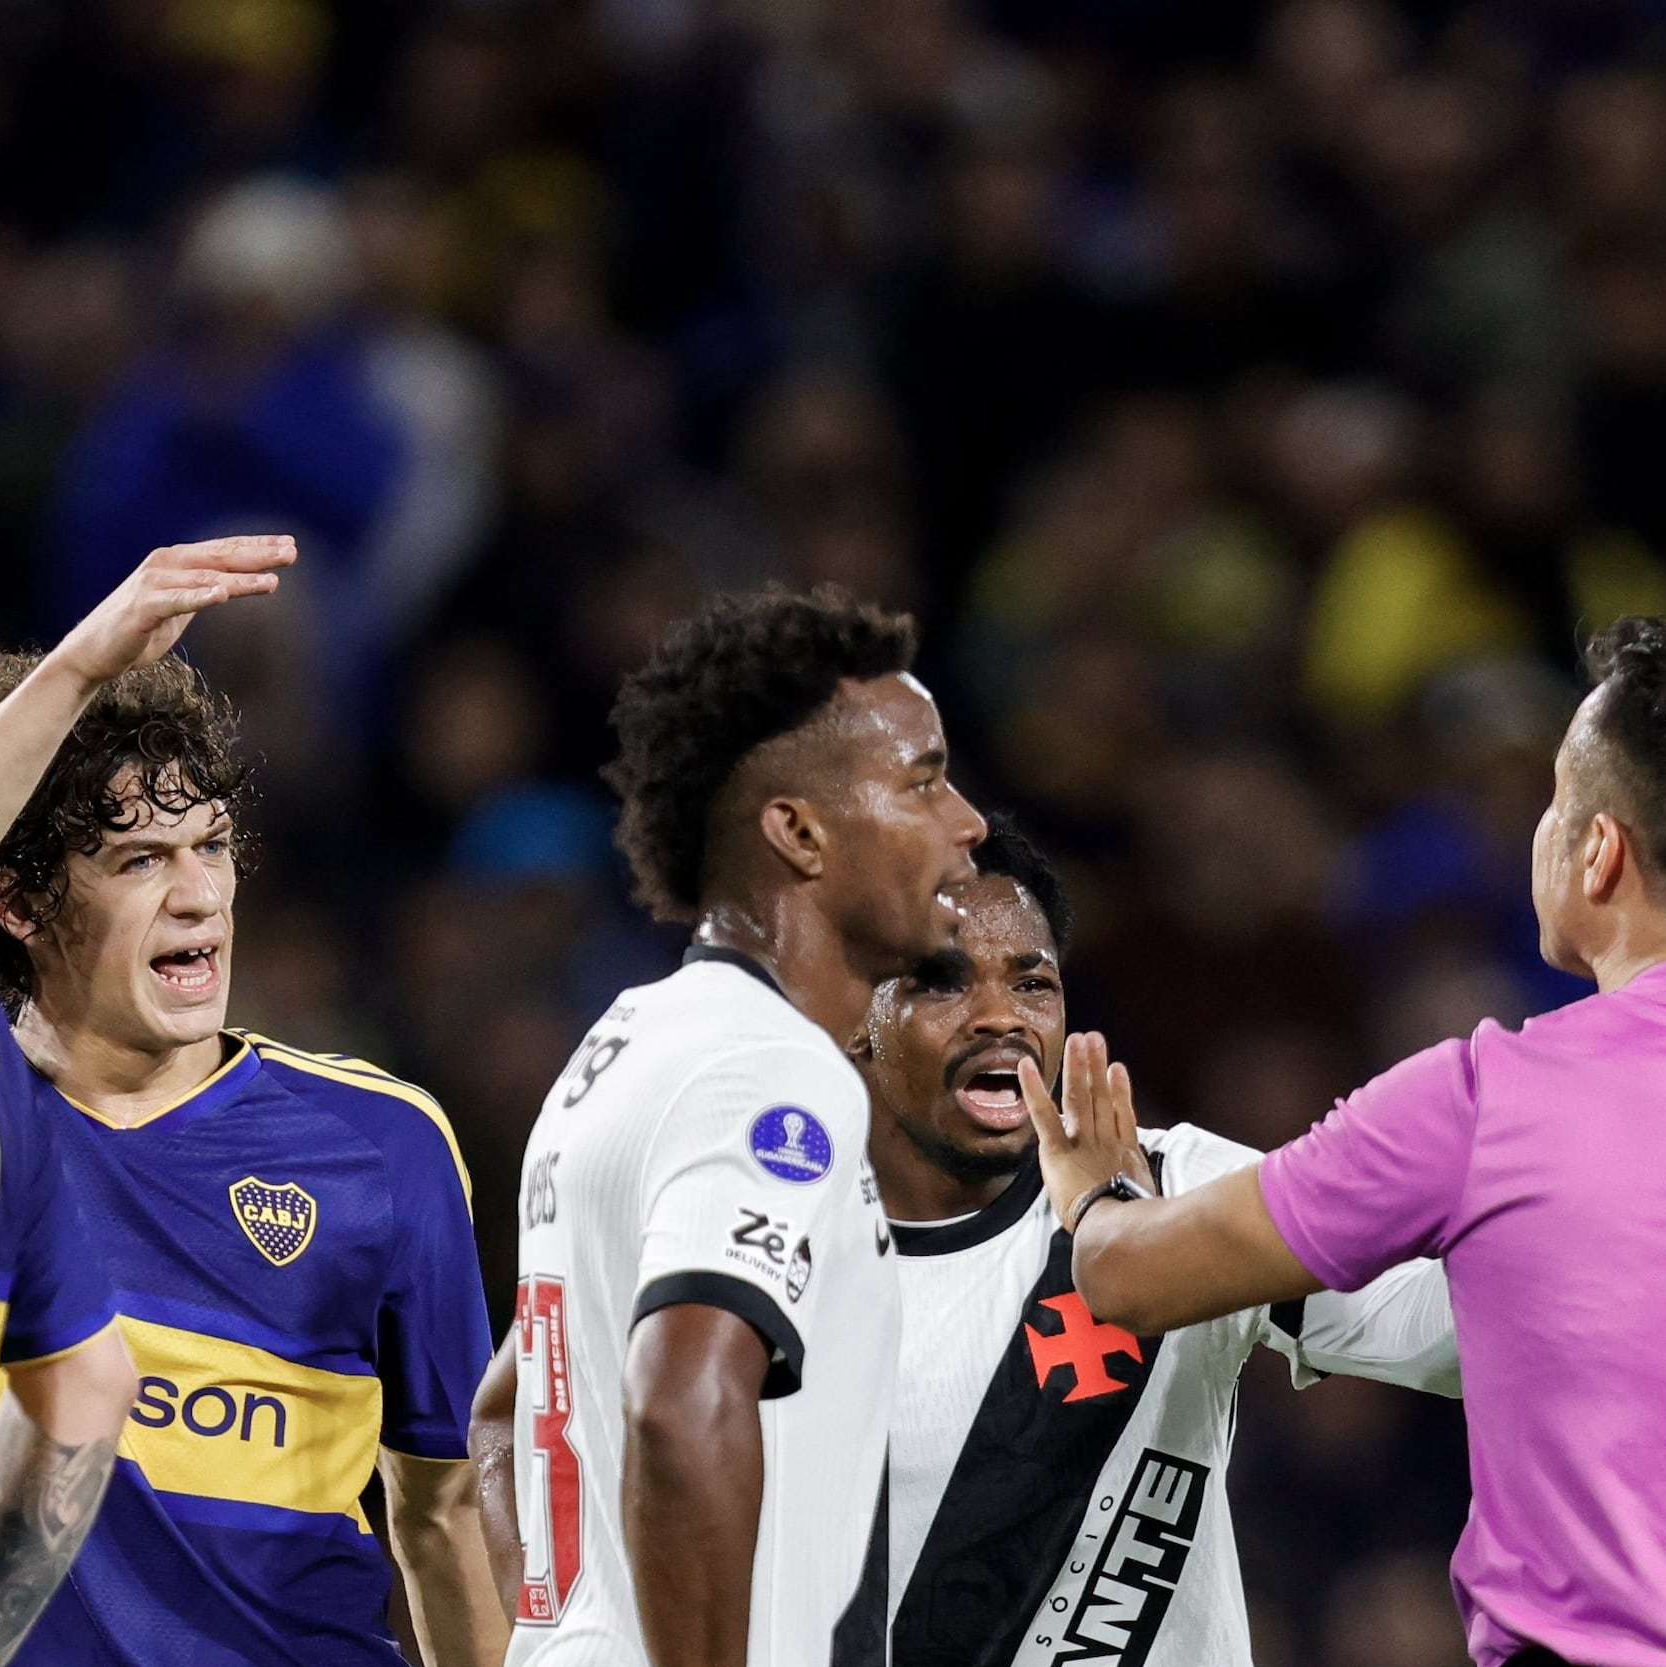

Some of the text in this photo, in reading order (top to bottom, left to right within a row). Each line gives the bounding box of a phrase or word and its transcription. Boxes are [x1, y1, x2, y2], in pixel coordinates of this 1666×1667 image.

[243, 1204, 305, 1230] CABJ
[725, 1248, 782, 1283] DELIVERY
[1036, 1495, 1115, 1648] SÓCIO
